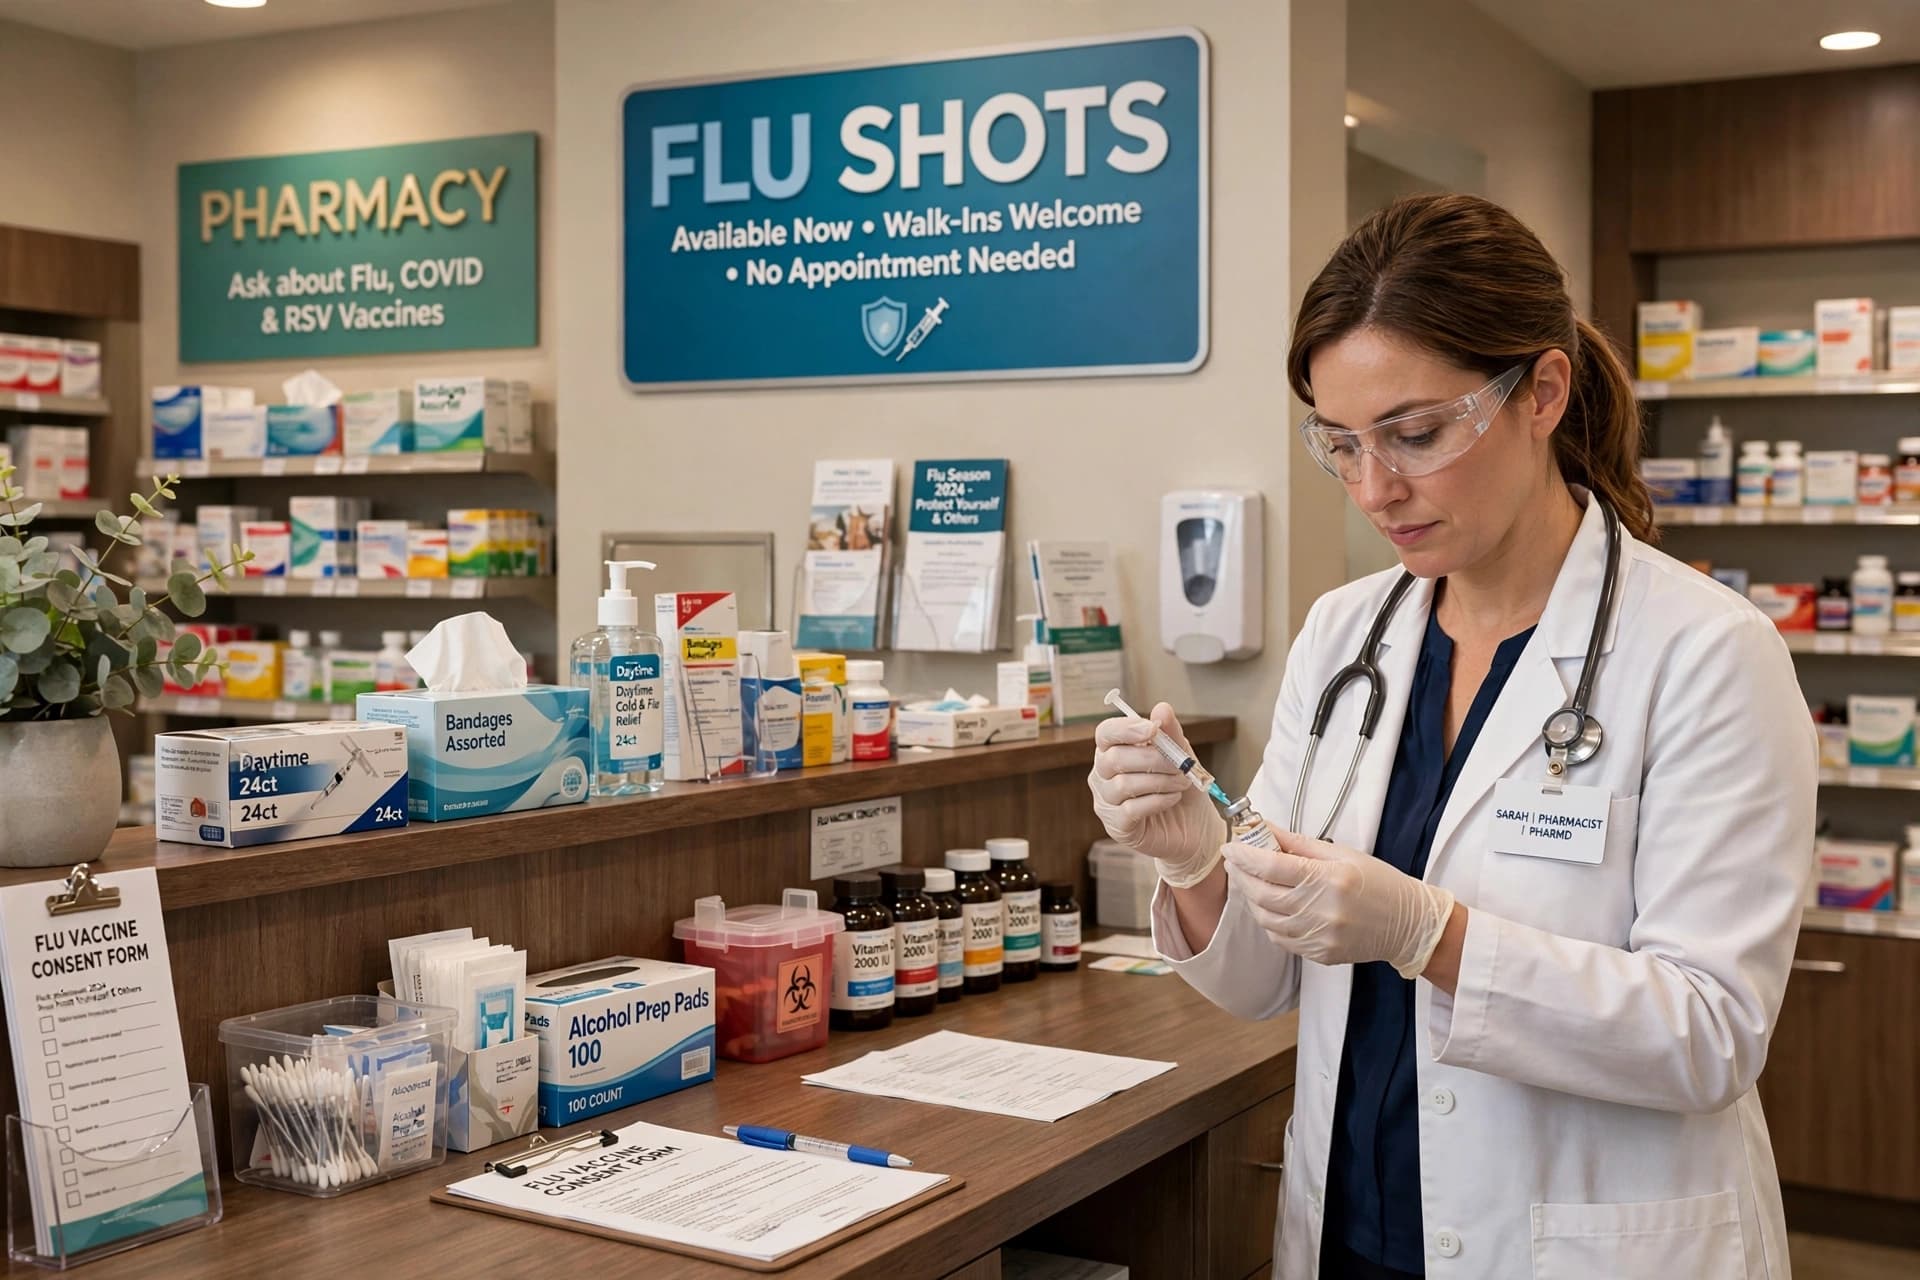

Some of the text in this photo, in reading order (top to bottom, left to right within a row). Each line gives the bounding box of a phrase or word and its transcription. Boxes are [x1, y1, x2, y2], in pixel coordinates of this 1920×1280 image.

[650, 80, 1170, 207] FLU SHOTS
[201, 166, 507, 242] PHARMACY
[671, 218, 787, 253] Available
[793, 216, 853, 244] Now
[882, 207, 1003, 238] Walk-Ins
[1008, 199, 1142, 230] Welcome
[746, 258, 783, 286] No
[788, 249, 962, 289] Appointment
[968, 239, 1076, 274] Needed
[228, 257, 483, 300] Ask about Flu, COVID
[261, 300, 444, 334] & RSV Vaccines
[926, 468, 991, 482] Flu Season
[934, 482, 965, 497] 2024
[915, 496, 1001, 511] Protect Yourself
[943, 512, 979, 525] Others
[616, 664, 655, 681] Daytime
[616, 685, 654, 698] Daytime
[615, 700, 638, 713] Cold
[446, 711, 513, 732] Bandages
[616, 712, 642, 727] Relief
[446, 730, 507, 752] Assorted
[615, 734, 638, 747] 24ct
[239, 749, 310, 773] Daytime
[239, 775, 278, 797] 24ct
[241, 803, 279, 823] 24ct
[375, 805, 404, 824] 24ct
[1495, 808, 1529, 823] SARAH
[1538, 813, 1604, 830] PHARMACIST
[1529, 826, 1573, 841] PHARMD
[35, 919, 139, 953] FLU VACCINE
[902, 932, 934, 945] Vitamin
[852, 941, 889, 956] Vitamin
[903, 945, 927, 958] 2000
[32, 943, 149, 979] CONSENT FORM
[854, 956, 880, 969] 2000
[524, 1012, 550, 1028] Pads
[568, 987, 710, 1041] Alcohol Prep Pads
[568, 1039, 602, 1069] 100
[568, 1096, 587, 1114] 100
[588, 1087, 624, 1109] COUNT
[523, 1145, 650, 1191] FLU VACCINE
[544, 1145, 683, 1197] CONSENT FORM
